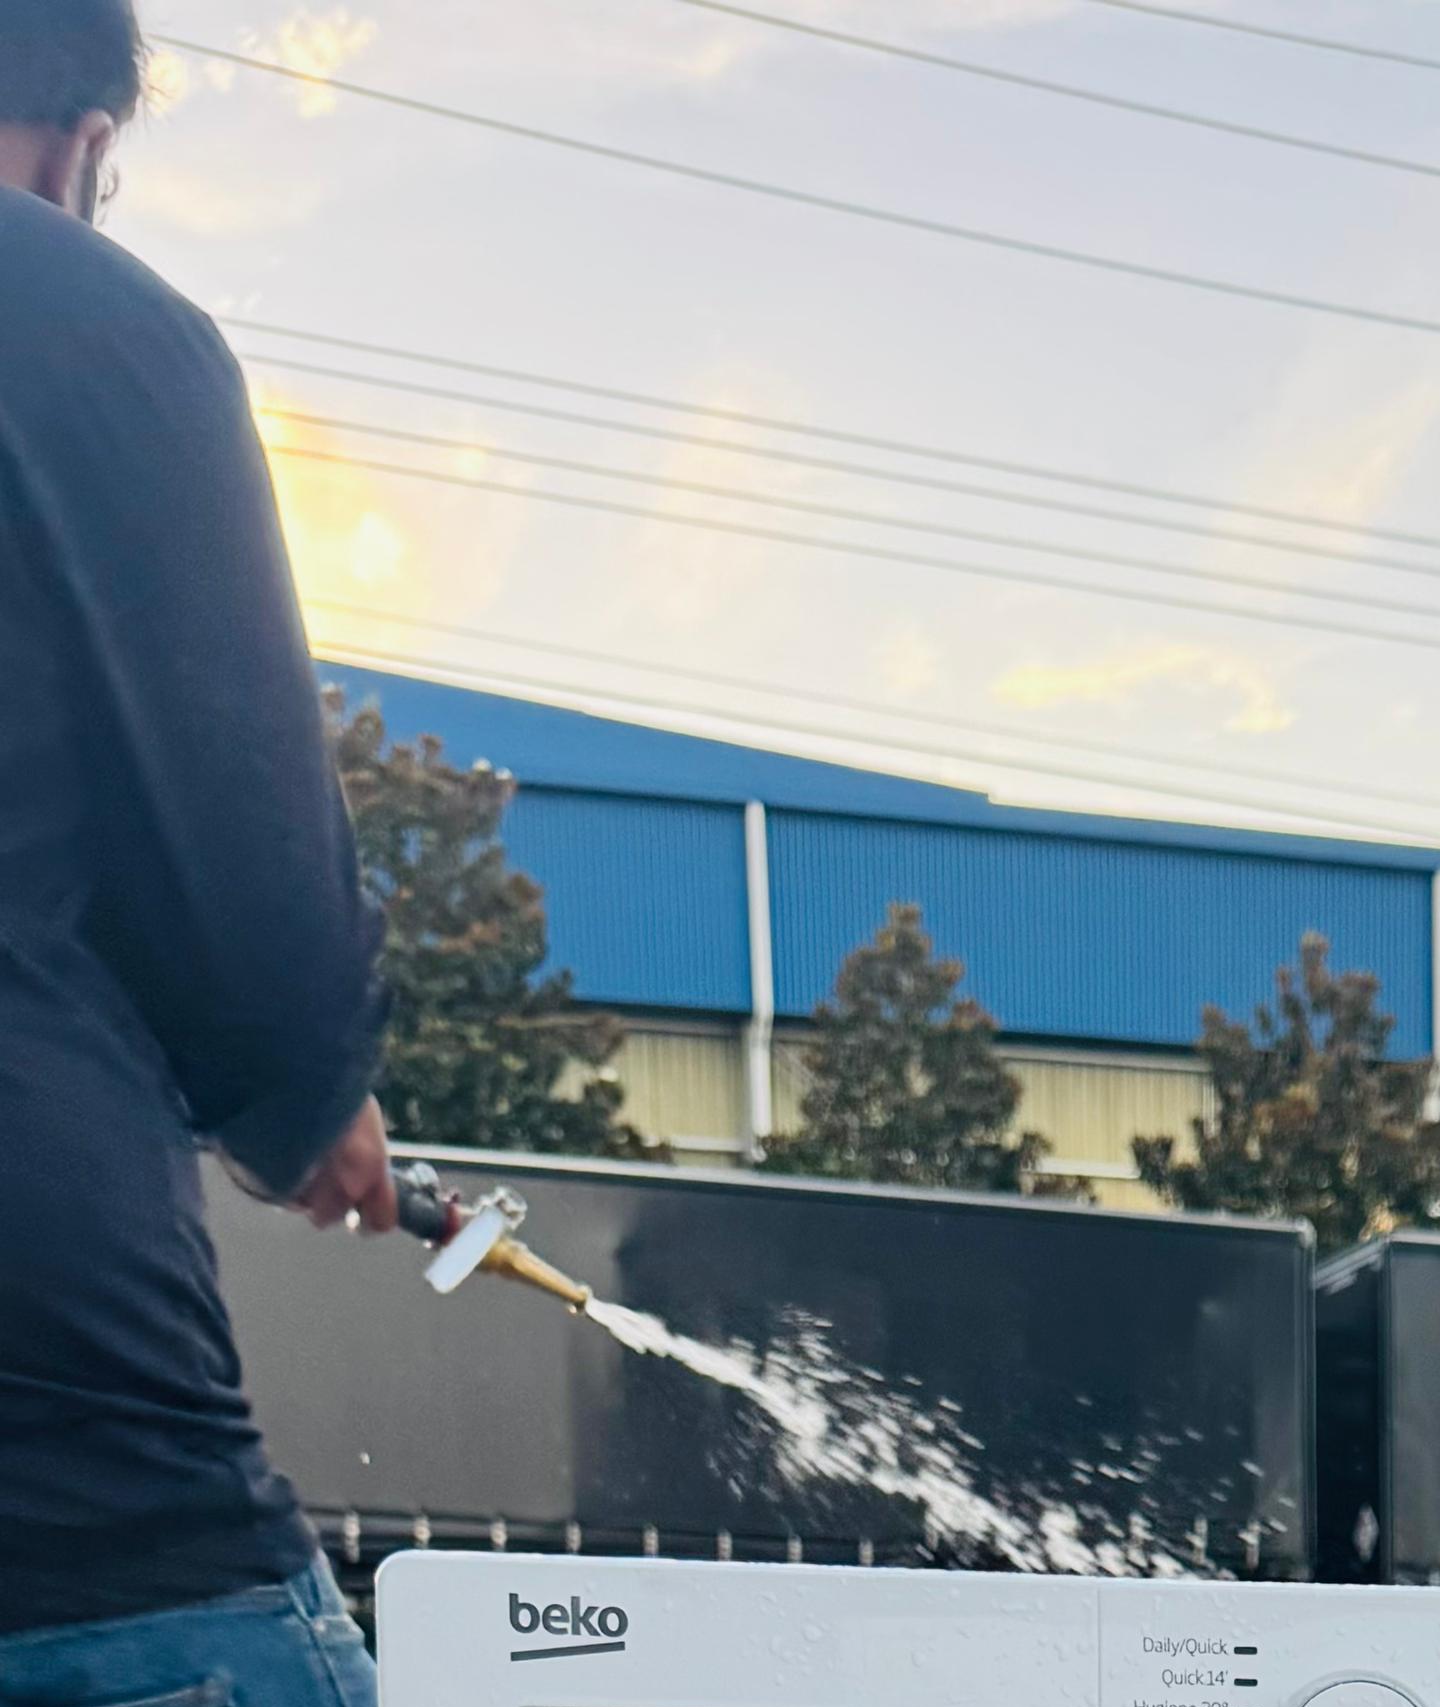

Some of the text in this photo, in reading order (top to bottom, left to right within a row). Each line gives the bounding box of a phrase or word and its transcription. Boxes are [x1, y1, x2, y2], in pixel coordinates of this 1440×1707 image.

[509, 1592, 628, 1638] beko
[1143, 1637, 1228, 1657] Daily/Quick
[1162, 1668, 1204, 1688] Quick
